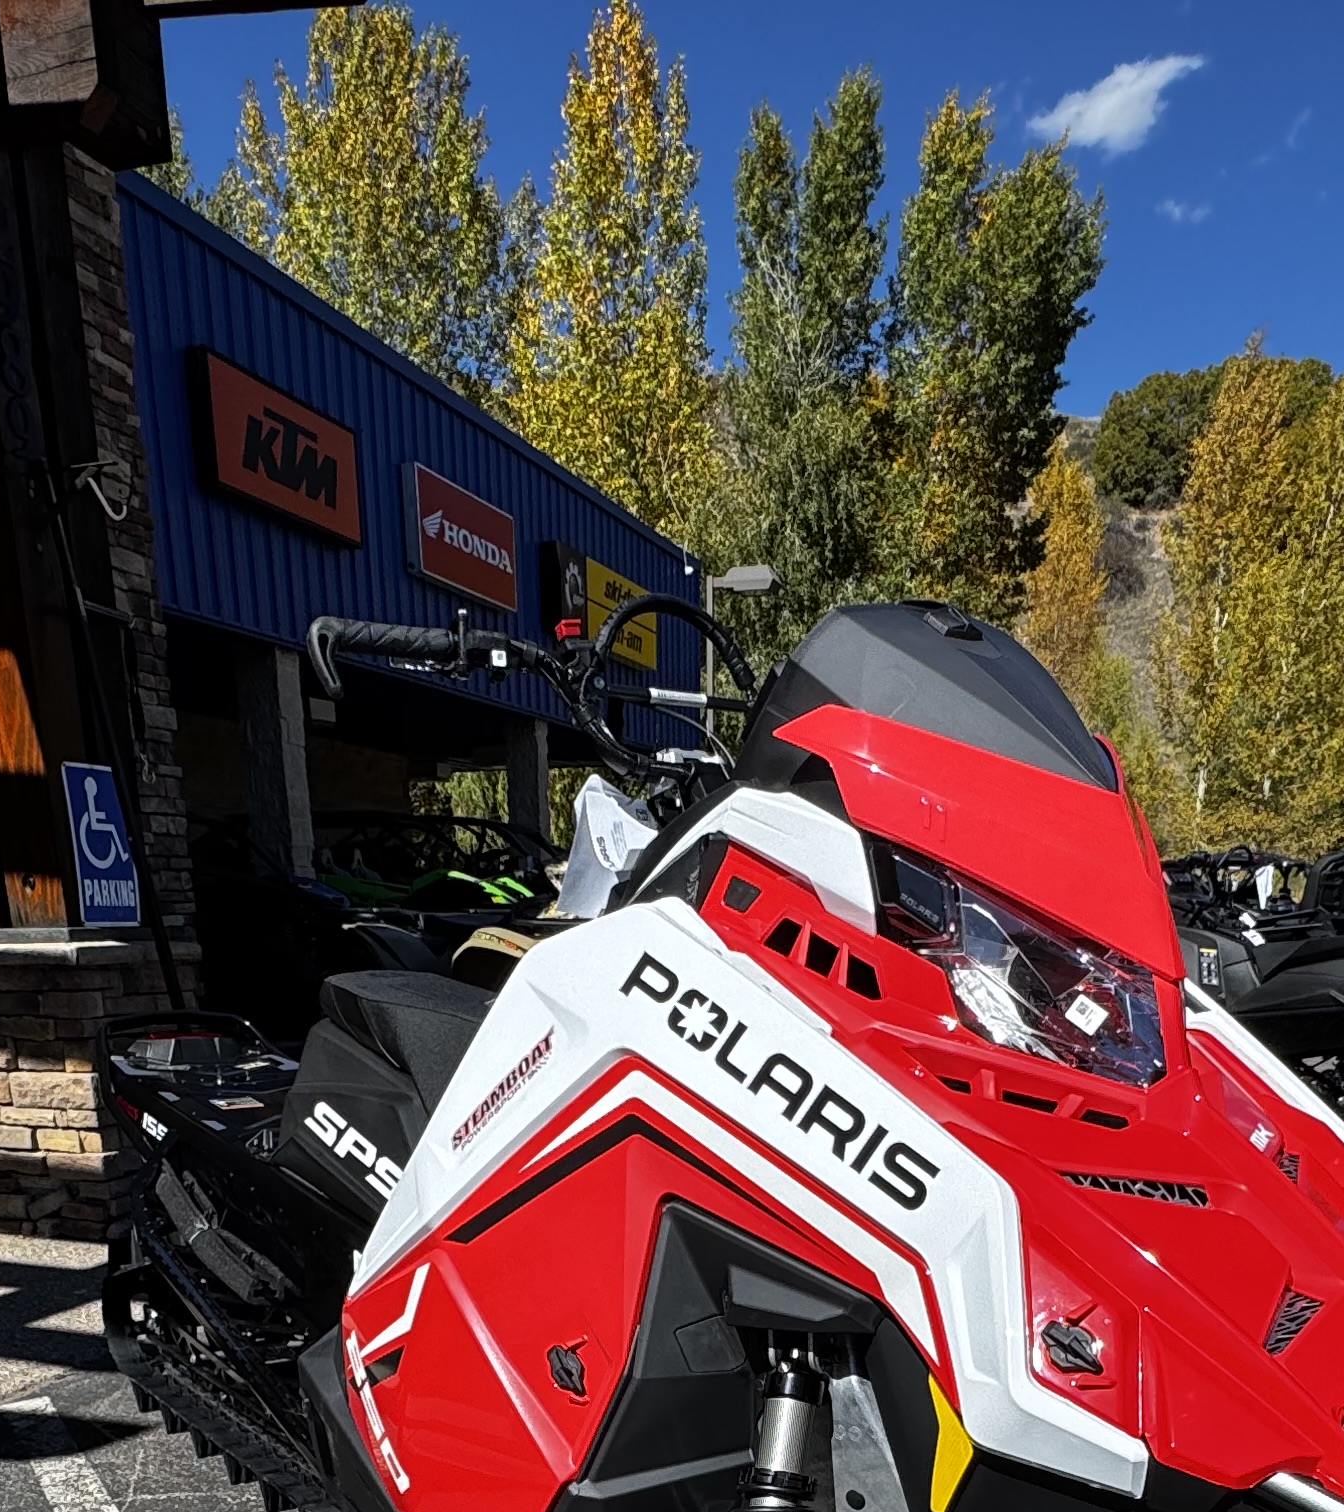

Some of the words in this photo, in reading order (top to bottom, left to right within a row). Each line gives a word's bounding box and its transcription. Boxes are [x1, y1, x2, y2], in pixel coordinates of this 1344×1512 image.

[242, 406, 337, 510] KTM
[441, 518, 514, 574] HONDA
[84, 878, 136, 907] PARKING
[451, 1025, 555, 1150] STEAMBOAT
[618, 951, 941, 1211] POLARIS
